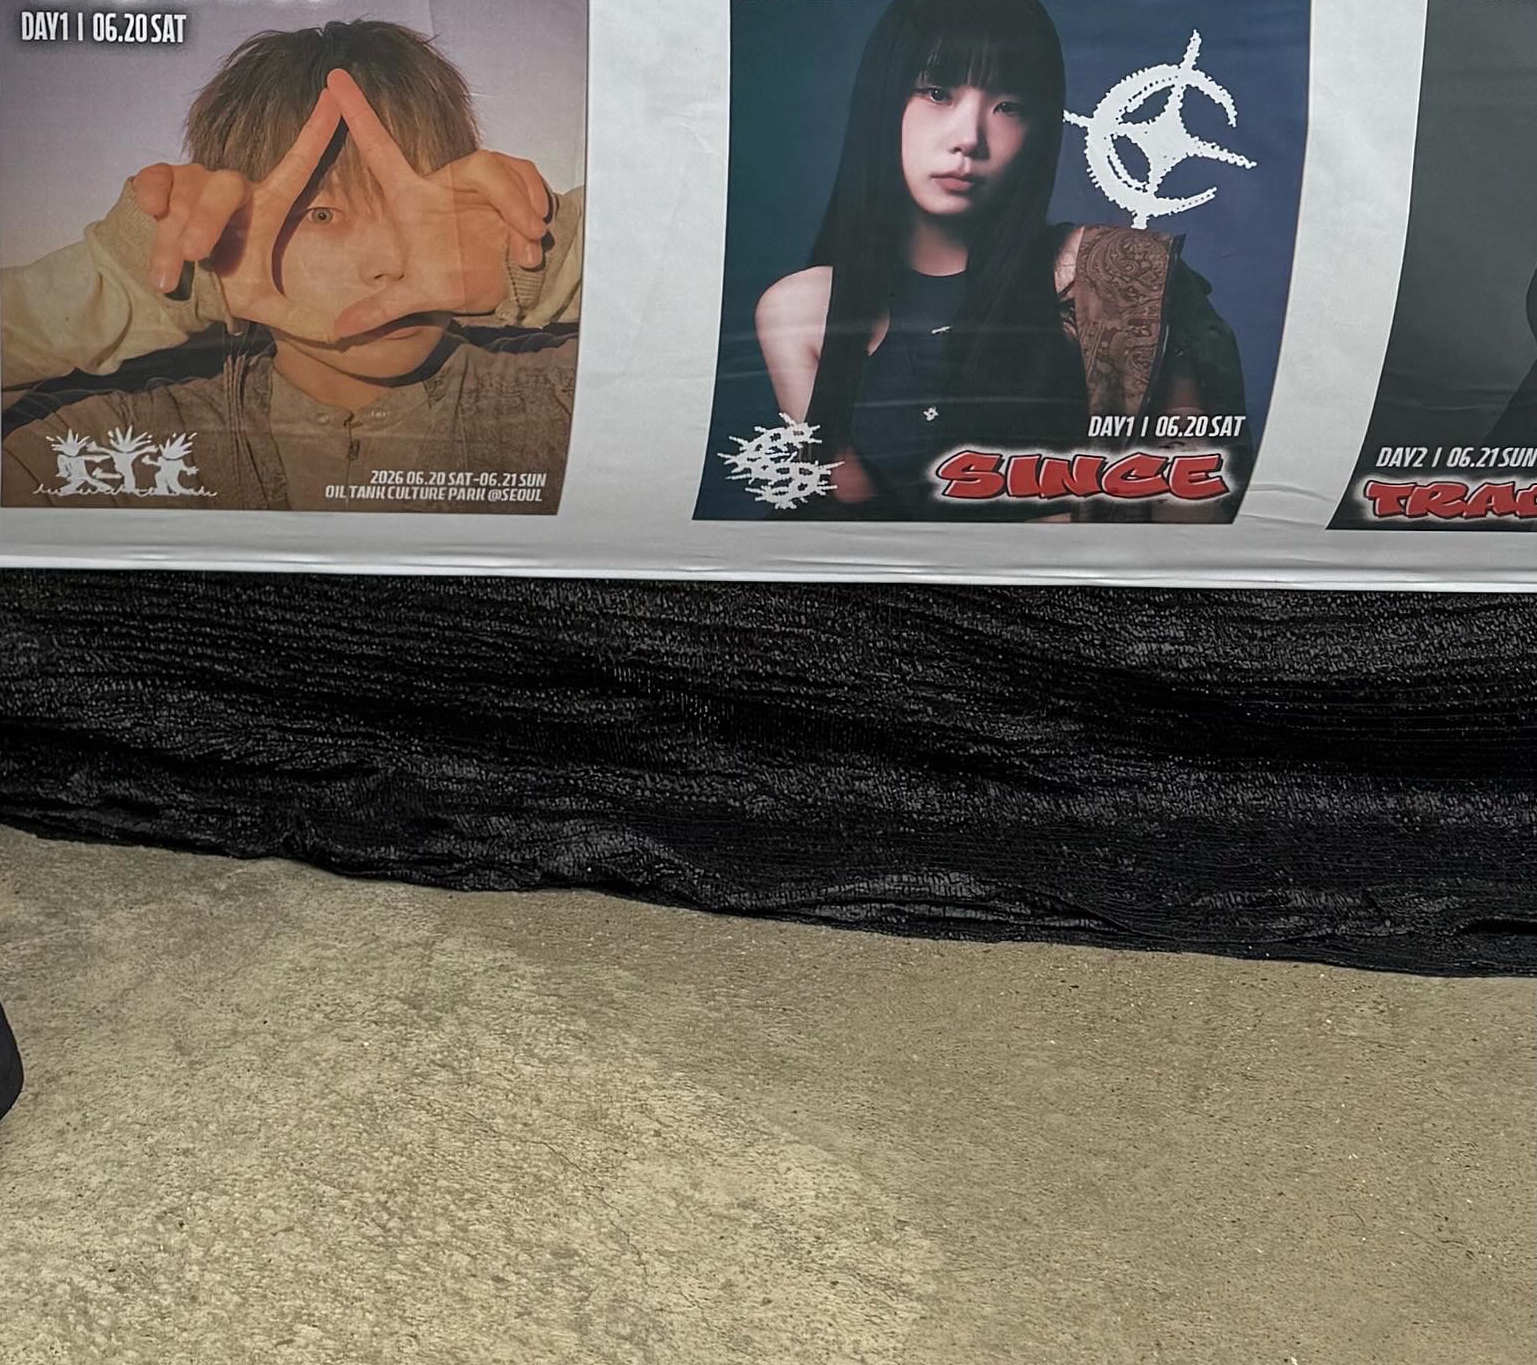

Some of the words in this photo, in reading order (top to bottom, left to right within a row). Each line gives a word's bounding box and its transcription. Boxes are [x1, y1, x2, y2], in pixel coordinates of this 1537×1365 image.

[21, 11, 69, 42] DAY1
[92, 12, 145, 43] 06.20
[150, 13, 187, 44] SAT
[1087, 415, 1135, 438] DAY1
[1154, 415, 1207, 438] 06.20
[1208, 415, 1247, 438] SAT
[1375, 447, 1428, 468] DAY2
[1446, 447, 1502, 468] 06.21
[935, 449, 1231, 500] SINCE
